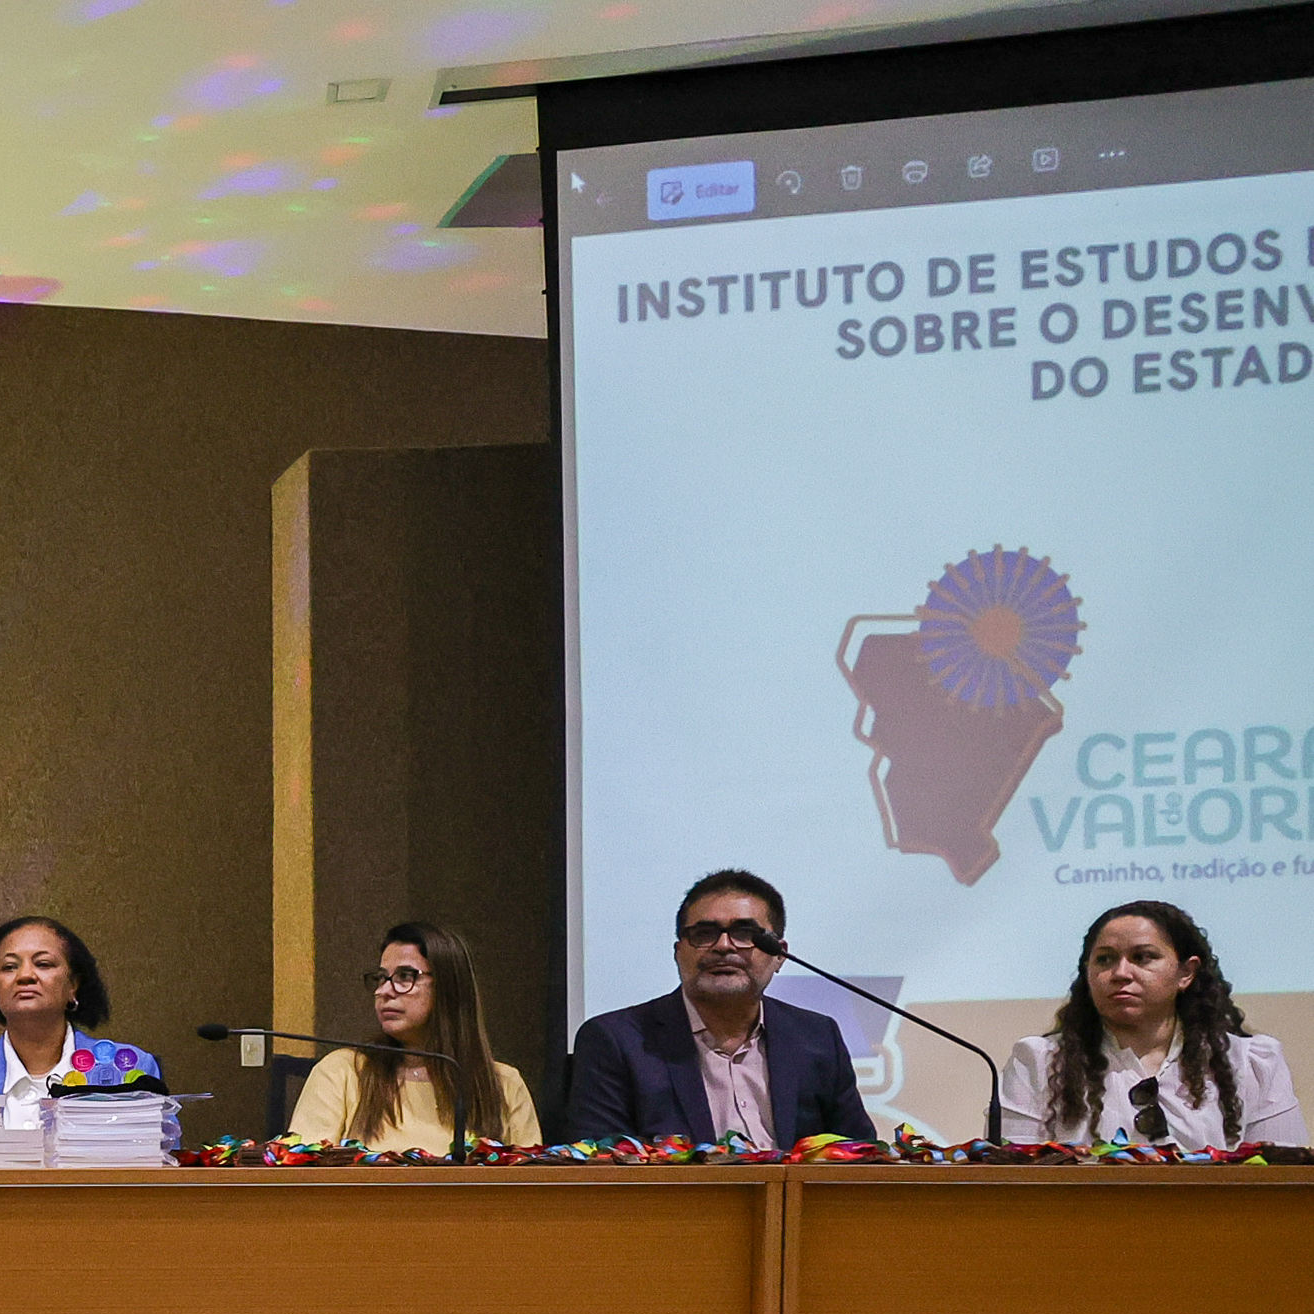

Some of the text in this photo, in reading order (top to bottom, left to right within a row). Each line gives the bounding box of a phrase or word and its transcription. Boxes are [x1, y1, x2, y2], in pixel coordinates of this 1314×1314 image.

[617, 259, 904, 323] INSTITUTO
[927, 254, 996, 298] DE
[1020, 229, 1283, 290] ESTUDOS
[836, 307, 1017, 361] SOBRE
[1038, 302, 1078, 345] O
[1030, 341, 1314, 400] DO ESTAD
[1076, 725, 1314, 791] CEAR
[1027, 785, 1314, 853] VALOR
[1054, 861, 1165, 885] Caminho,
[1173, 857, 1267, 884] tradição
[1272, 860, 1286, 876] e
